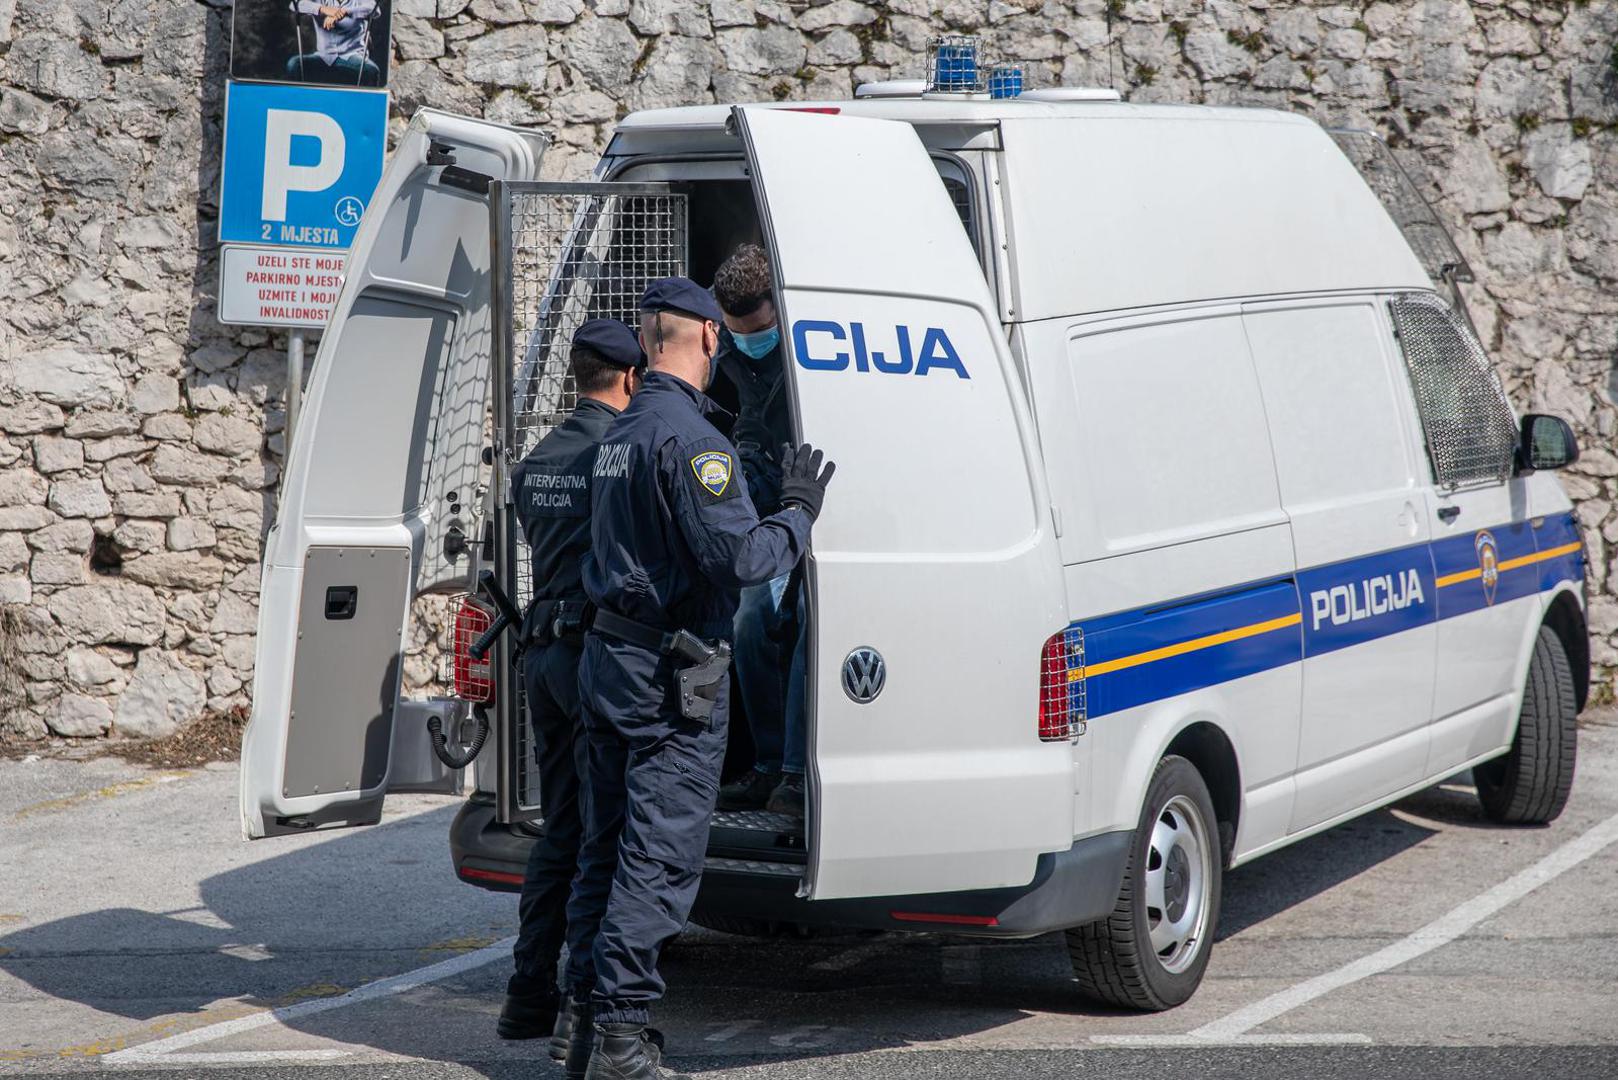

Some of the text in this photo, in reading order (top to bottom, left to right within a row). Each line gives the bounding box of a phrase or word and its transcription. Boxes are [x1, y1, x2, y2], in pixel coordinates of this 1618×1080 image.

[261, 109, 346, 222] P
[262, 224, 339, 245] 2 MJESTA
[257, 256, 344, 271] UZELI STE MOJE
[246, 272, 342, 288] PARKIRNO MJEST
[258, 289, 297, 302] UZMITE
[302, 292, 305, 302] I
[791, 319, 971, 380] CIJA
[523, 473, 587, 489] INTERVENTNA
[531, 492, 573, 508] POLICIJA
[1310, 568, 1425, 631] POLICIJA
